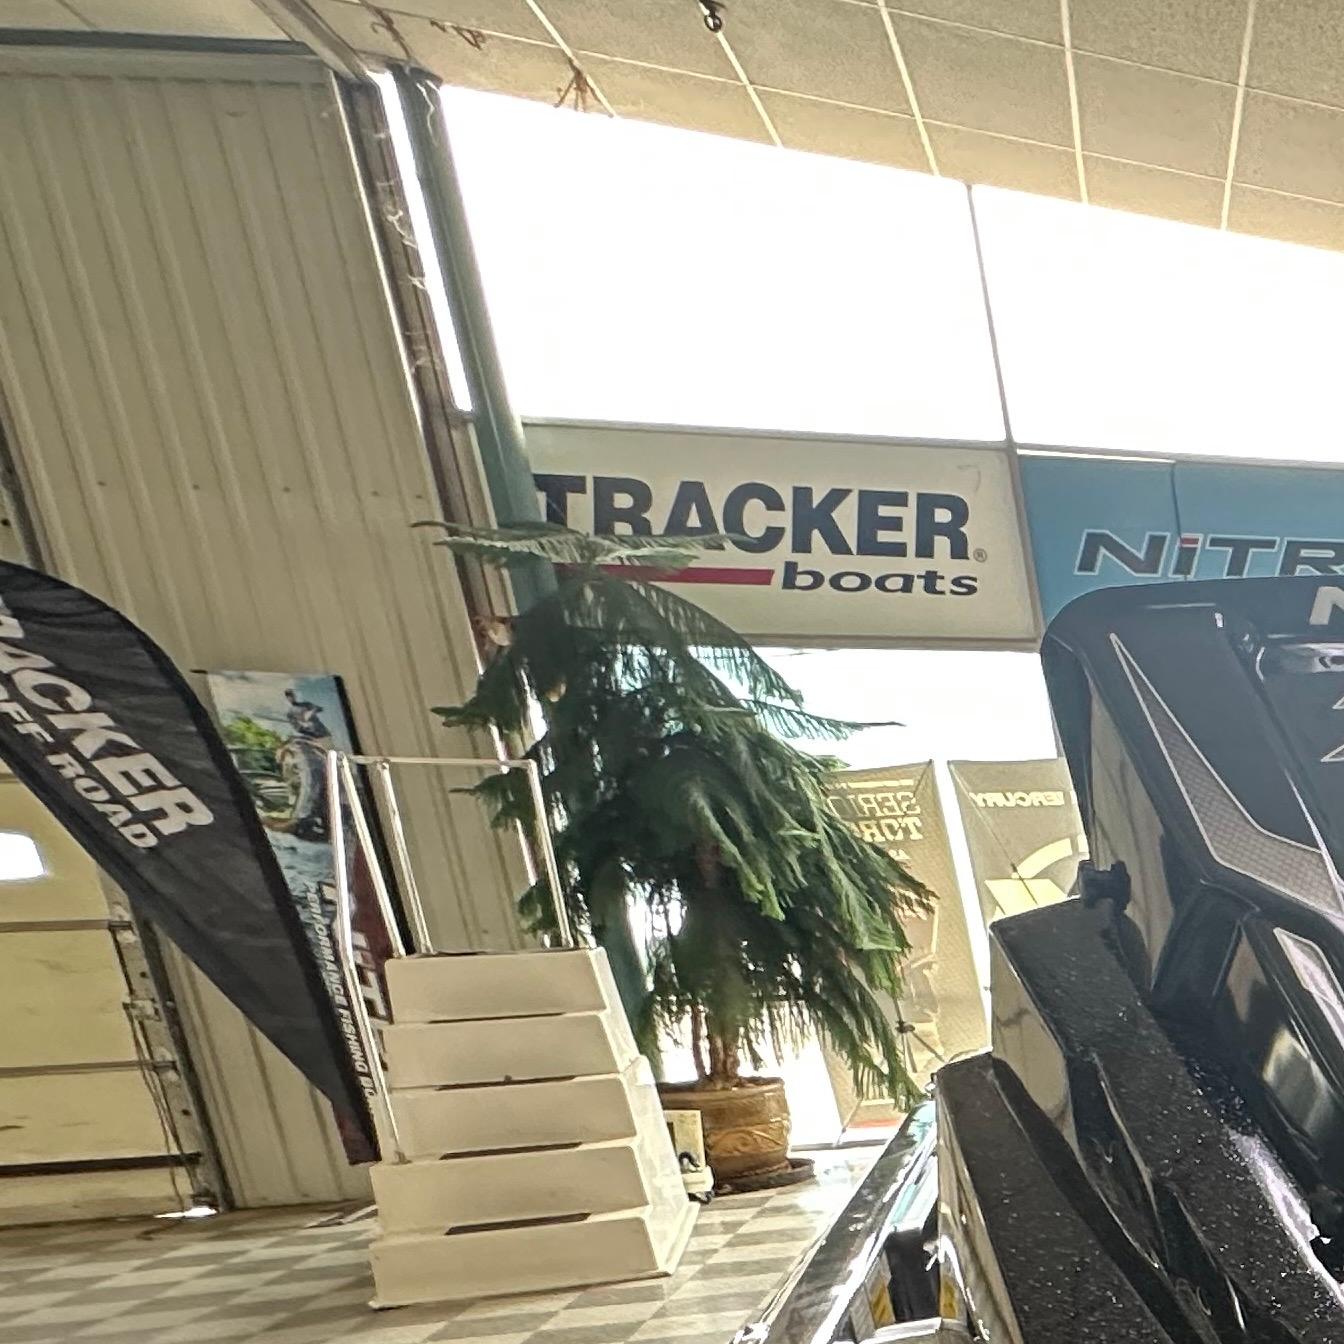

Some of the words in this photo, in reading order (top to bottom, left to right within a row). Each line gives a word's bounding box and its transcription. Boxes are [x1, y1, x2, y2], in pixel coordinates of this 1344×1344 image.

[532, 474, 970, 561] TRACKER
[781, 561, 978, 596] boats
[0, 594, 214, 836] ACKER
[0, 682, 55, 743] FF
[47, 752, 158, 848] ROAD
